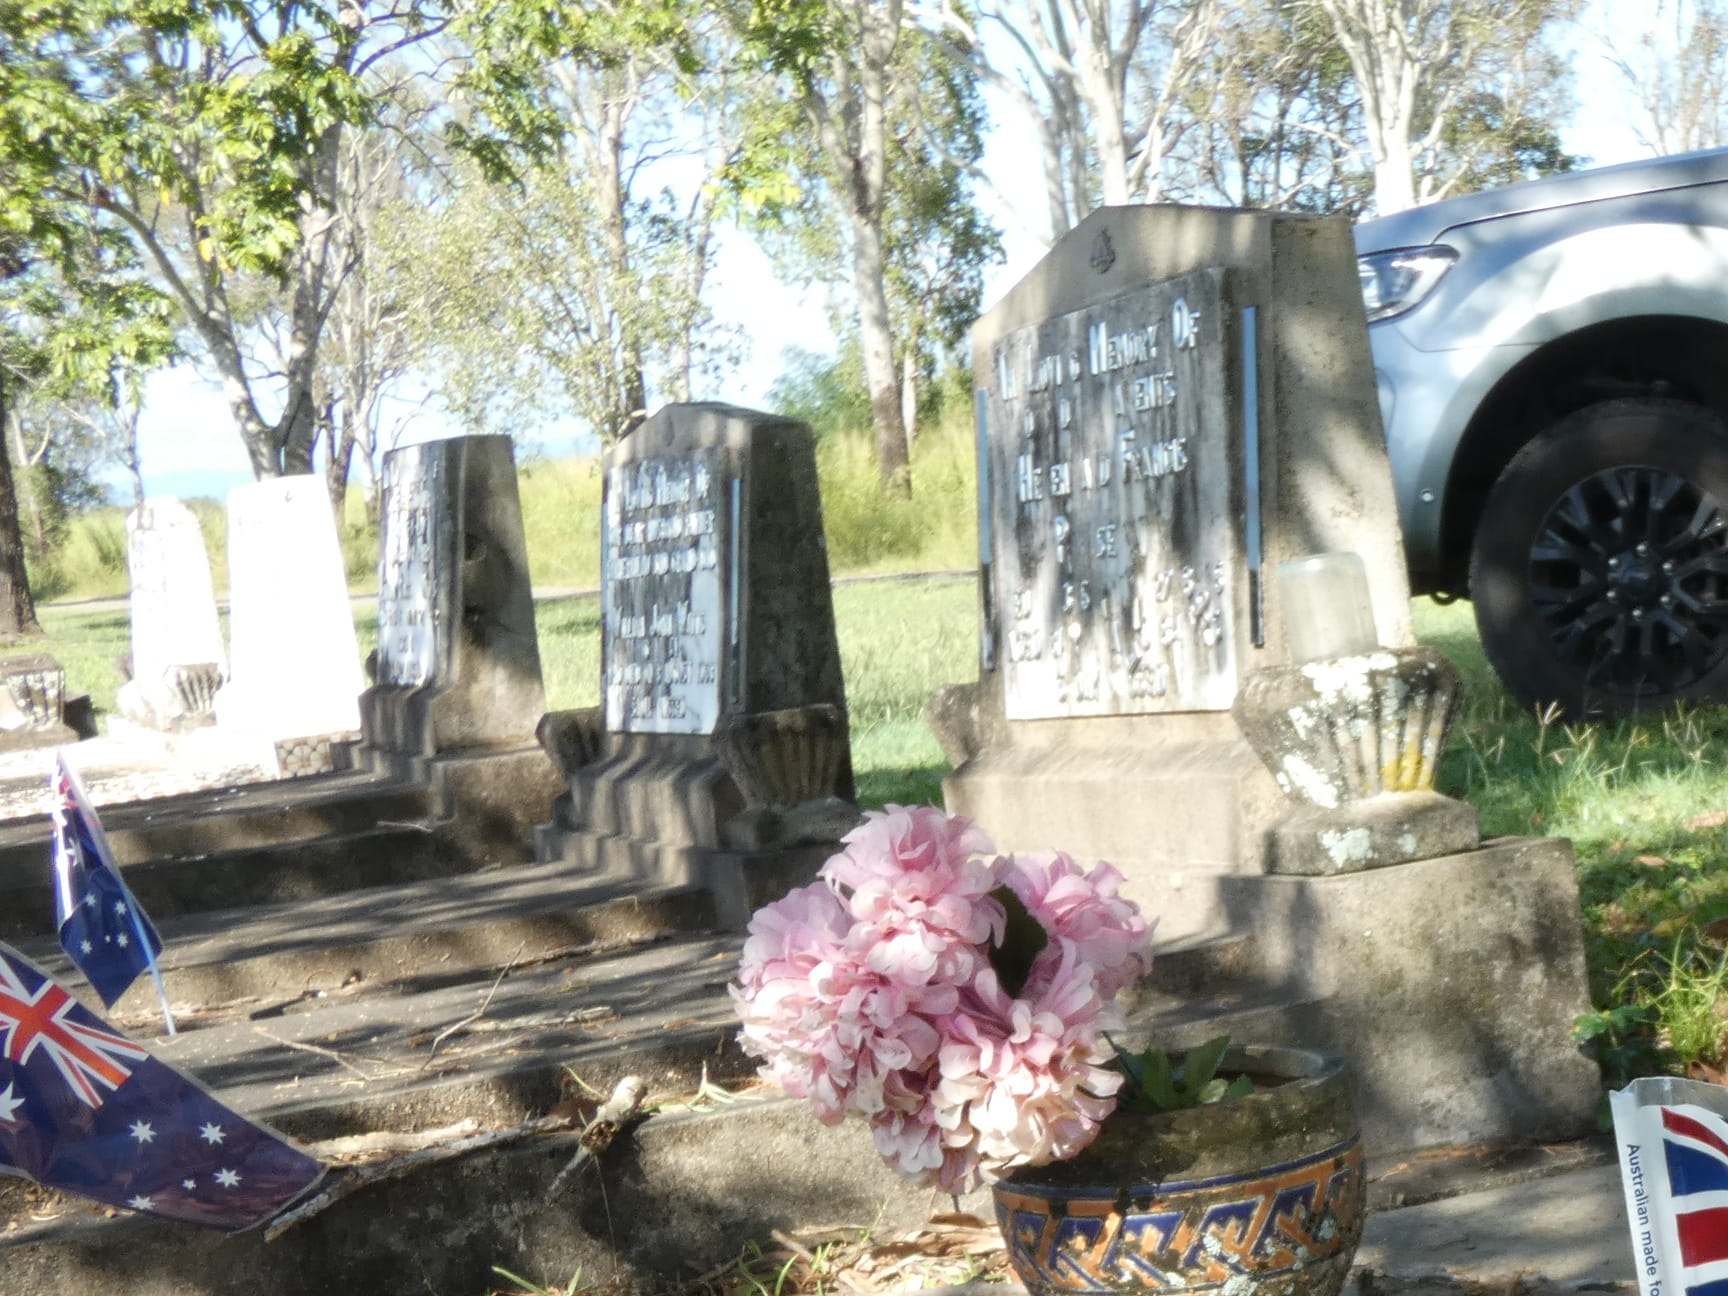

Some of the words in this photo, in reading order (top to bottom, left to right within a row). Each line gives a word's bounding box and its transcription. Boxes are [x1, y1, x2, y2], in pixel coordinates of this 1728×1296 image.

[1172, 297, 1200, 351] OF
[1627, 1143, 1649, 1226] Australian
[1641, 1230, 1658, 1276] made
